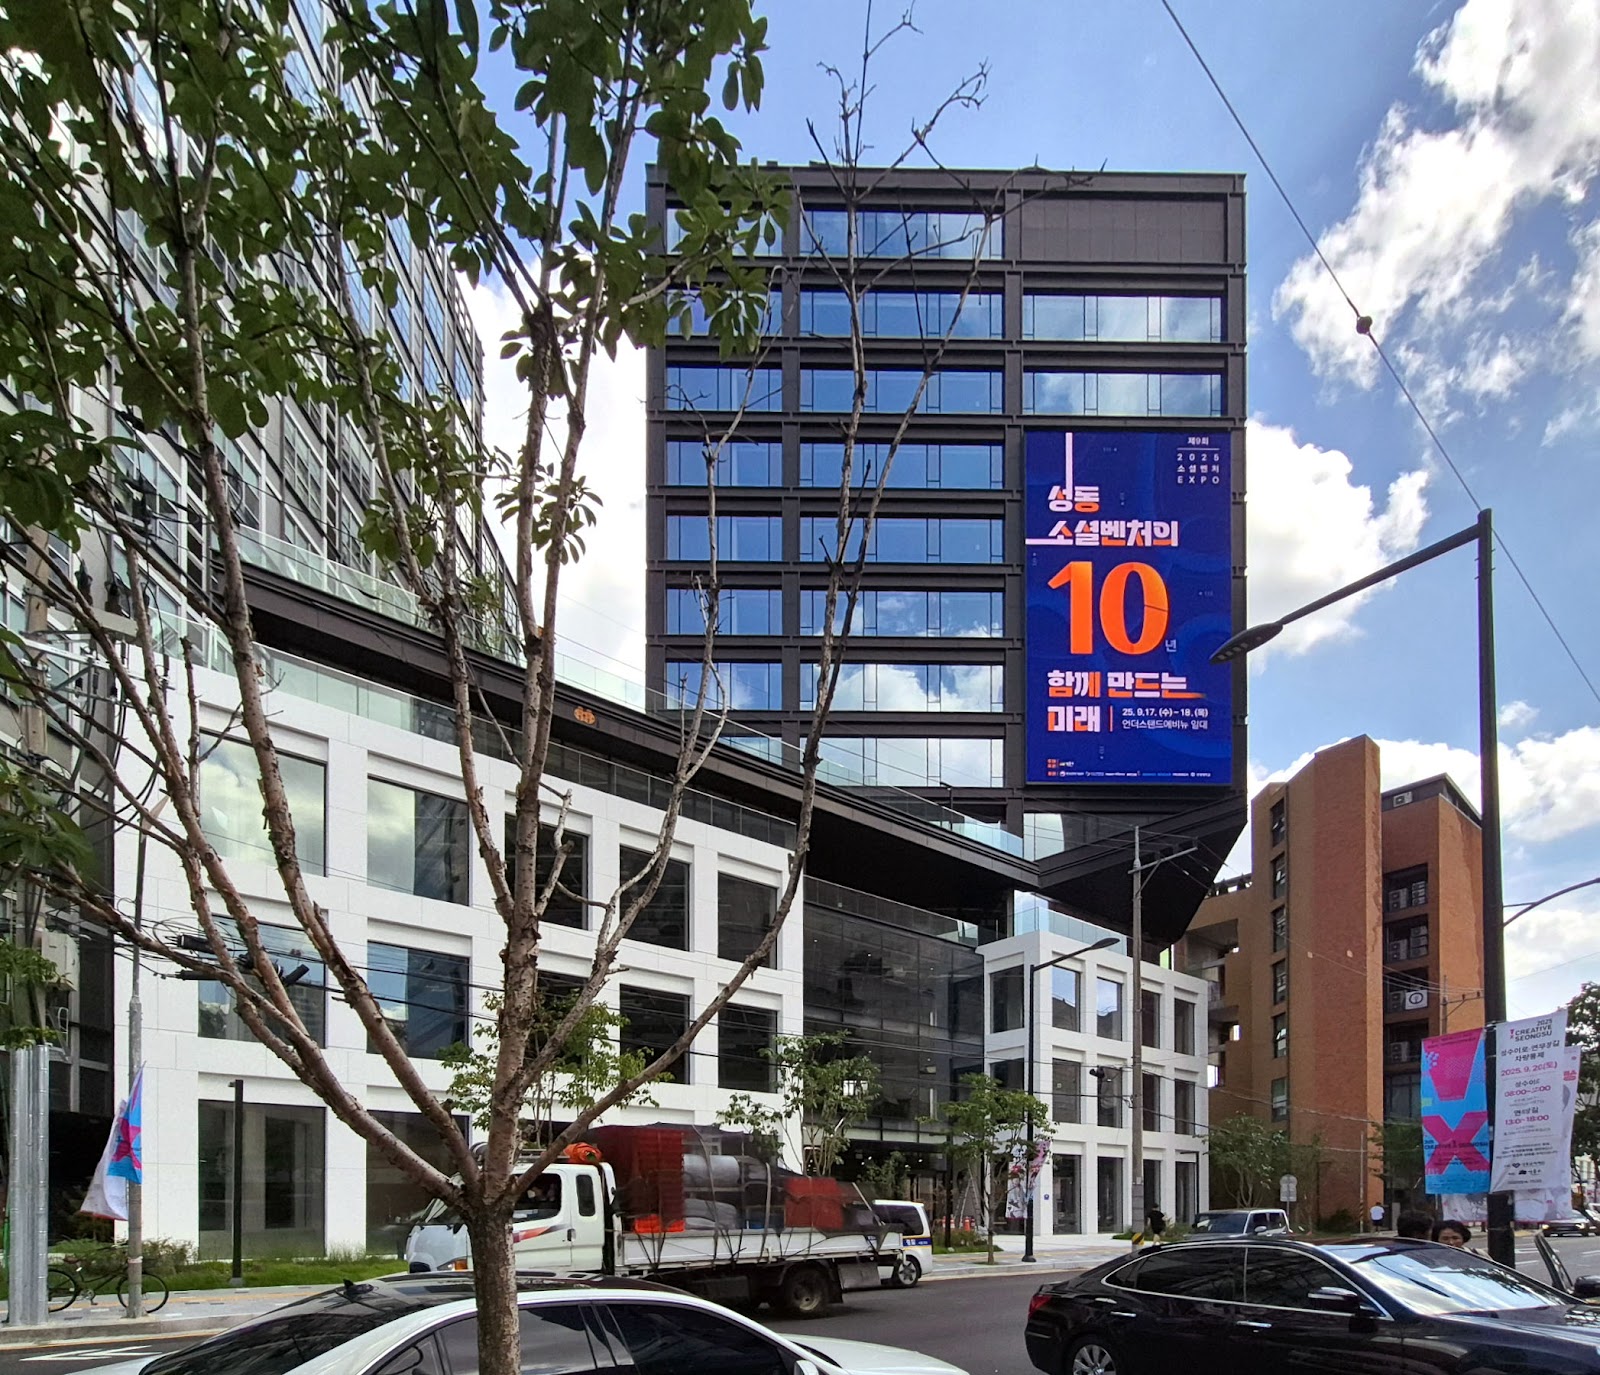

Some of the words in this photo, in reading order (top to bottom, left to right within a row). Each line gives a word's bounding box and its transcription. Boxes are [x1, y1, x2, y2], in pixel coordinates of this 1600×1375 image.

[1187, 436, 1209, 445] 제9회
[1176, 453, 1220, 461] 2025
[1176, 464, 1220, 473] 소셜벤처
[1177, 475, 1220, 484] EXPO
[1025, 519, 1179, 547] 소셜벤처의
[1047, 669, 1101, 698] 함께
[1107, 671, 1206, 699] 만드는
[1047, 705, 1101, 732] 미래
[1190, 719, 1208, 730] 일대
[1537, 1018, 1553, 1027] 2025
[1515, 1024, 1553, 1036] CREATIVE
[1515, 1030, 1553, 1042] SEONGSU
